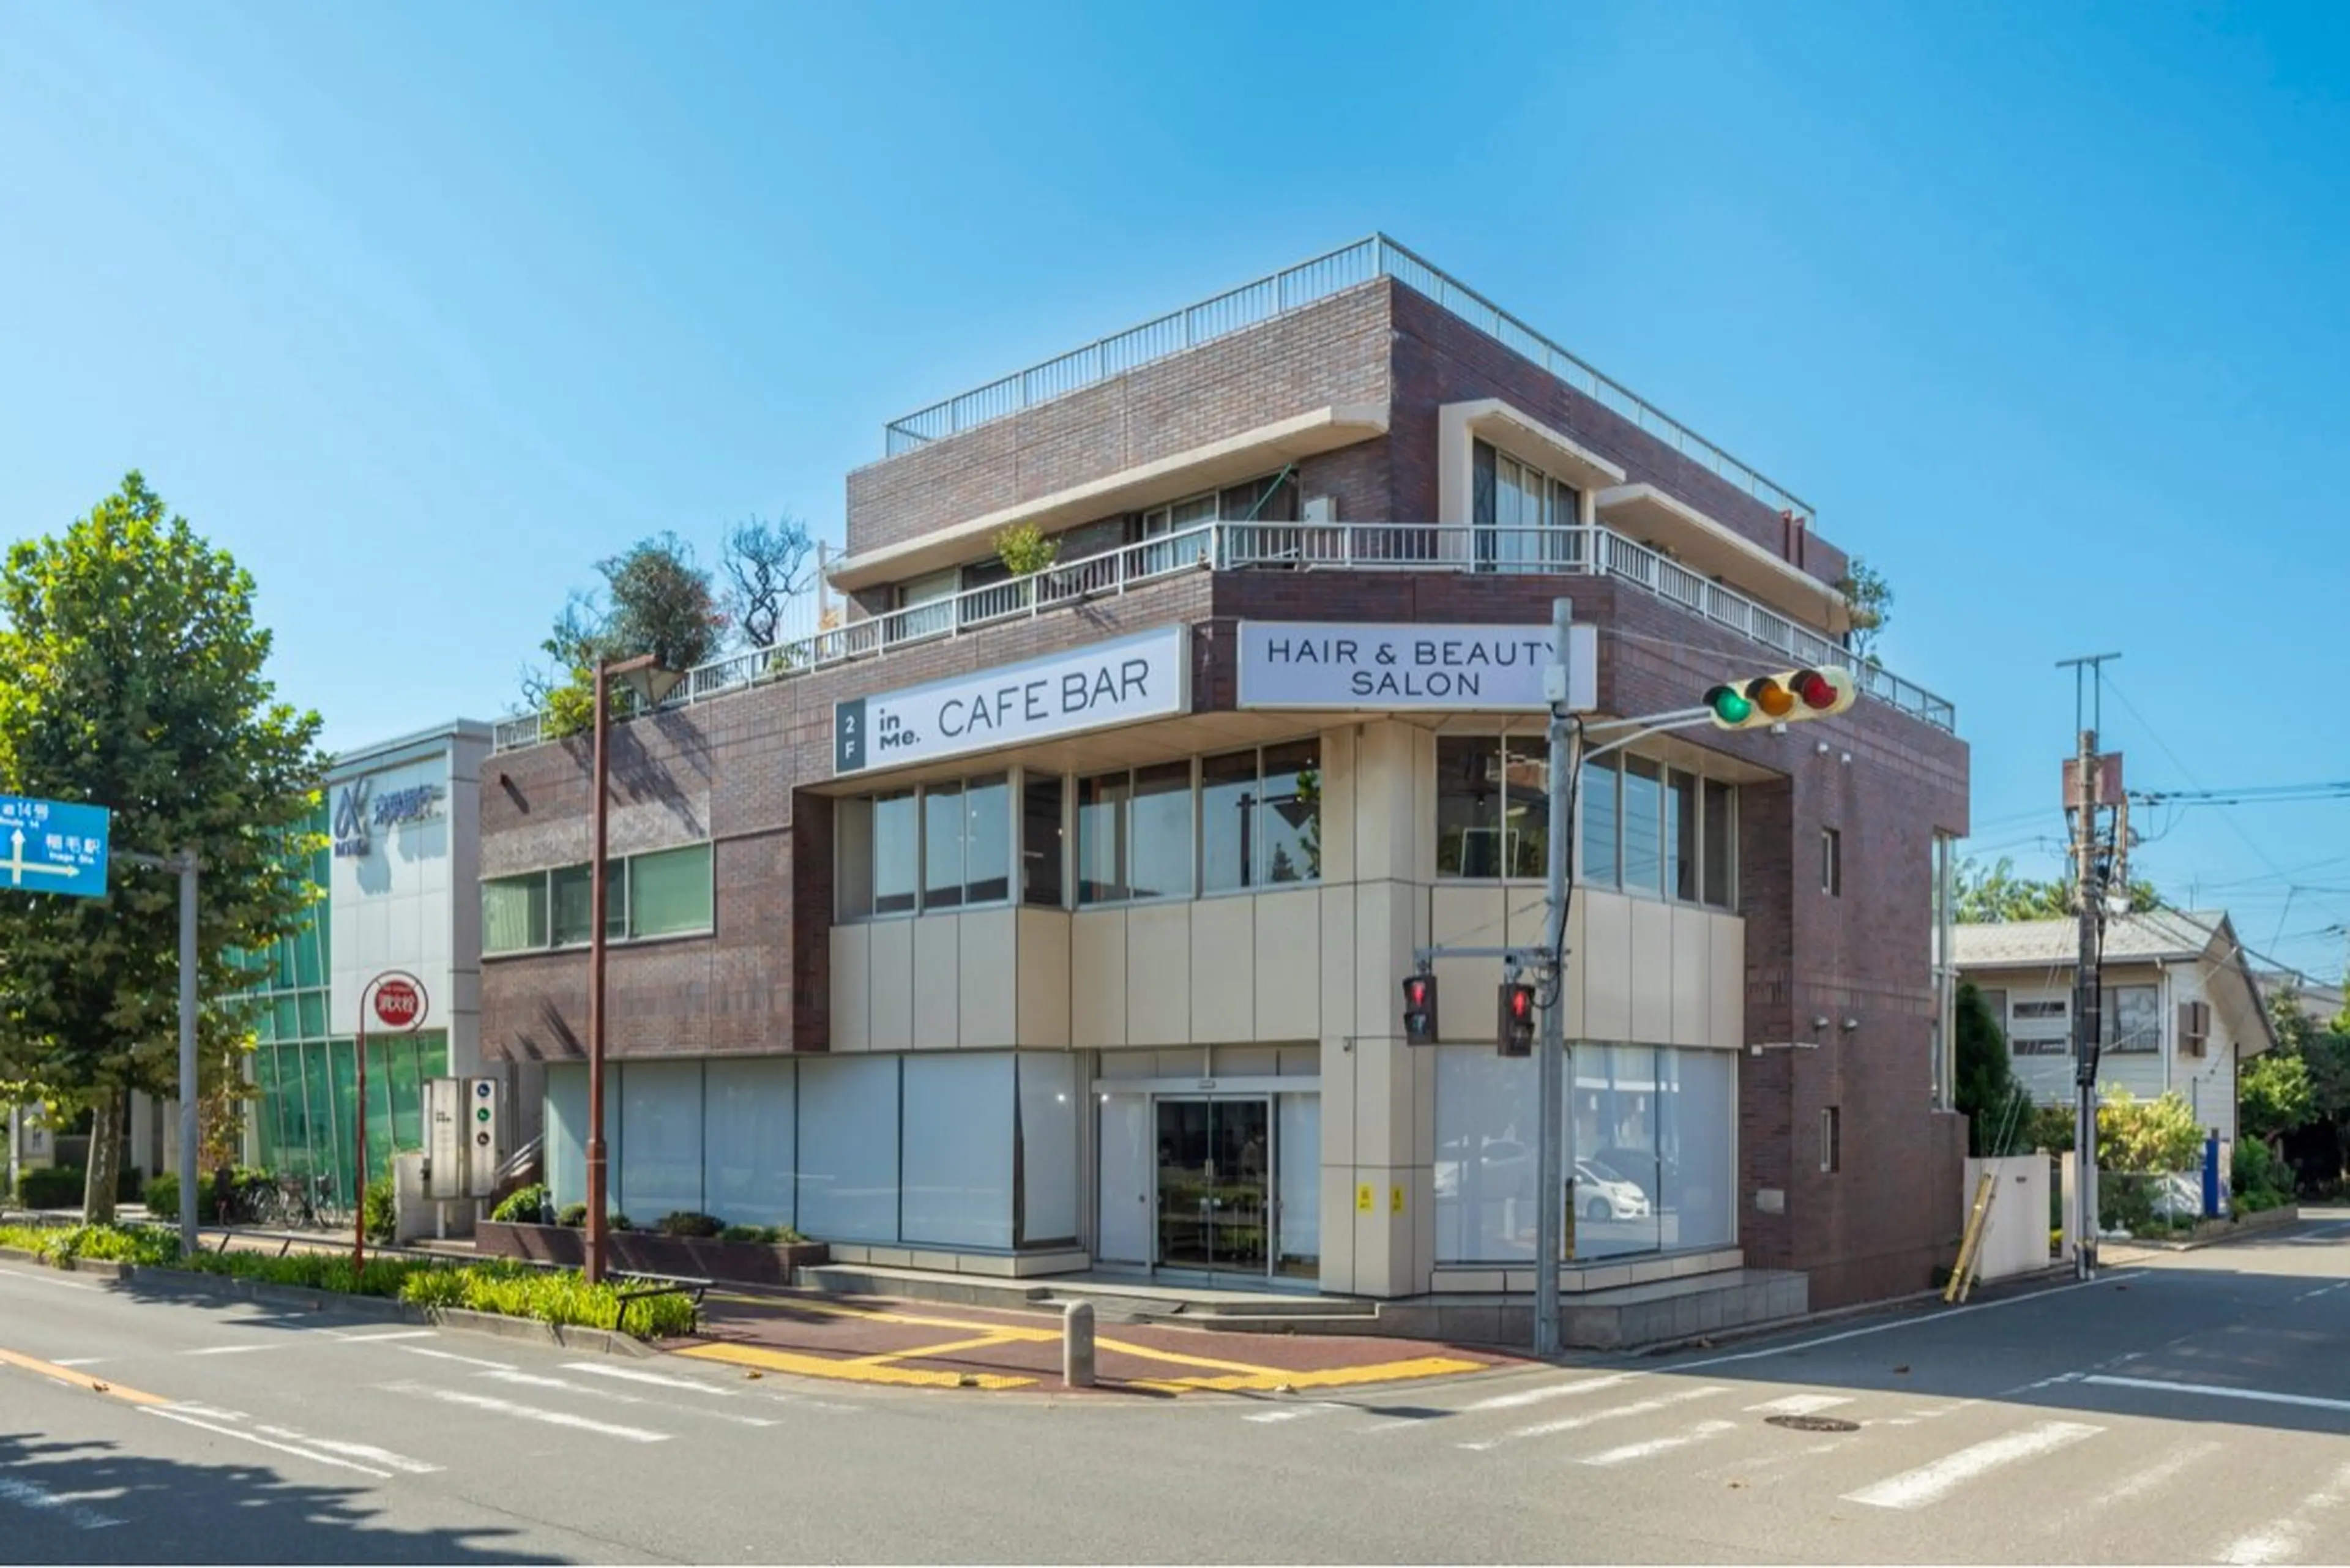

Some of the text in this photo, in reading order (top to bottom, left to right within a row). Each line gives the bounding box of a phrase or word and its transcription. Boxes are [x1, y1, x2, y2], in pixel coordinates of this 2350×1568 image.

[1269, 639, 1358, 665] HAIR
[1375, 643, 1397, 665] &
[1351, 671, 1480, 696] SALON
[938, 659, 1149, 737] CAFE BAR
[879, 708, 900, 732] in
